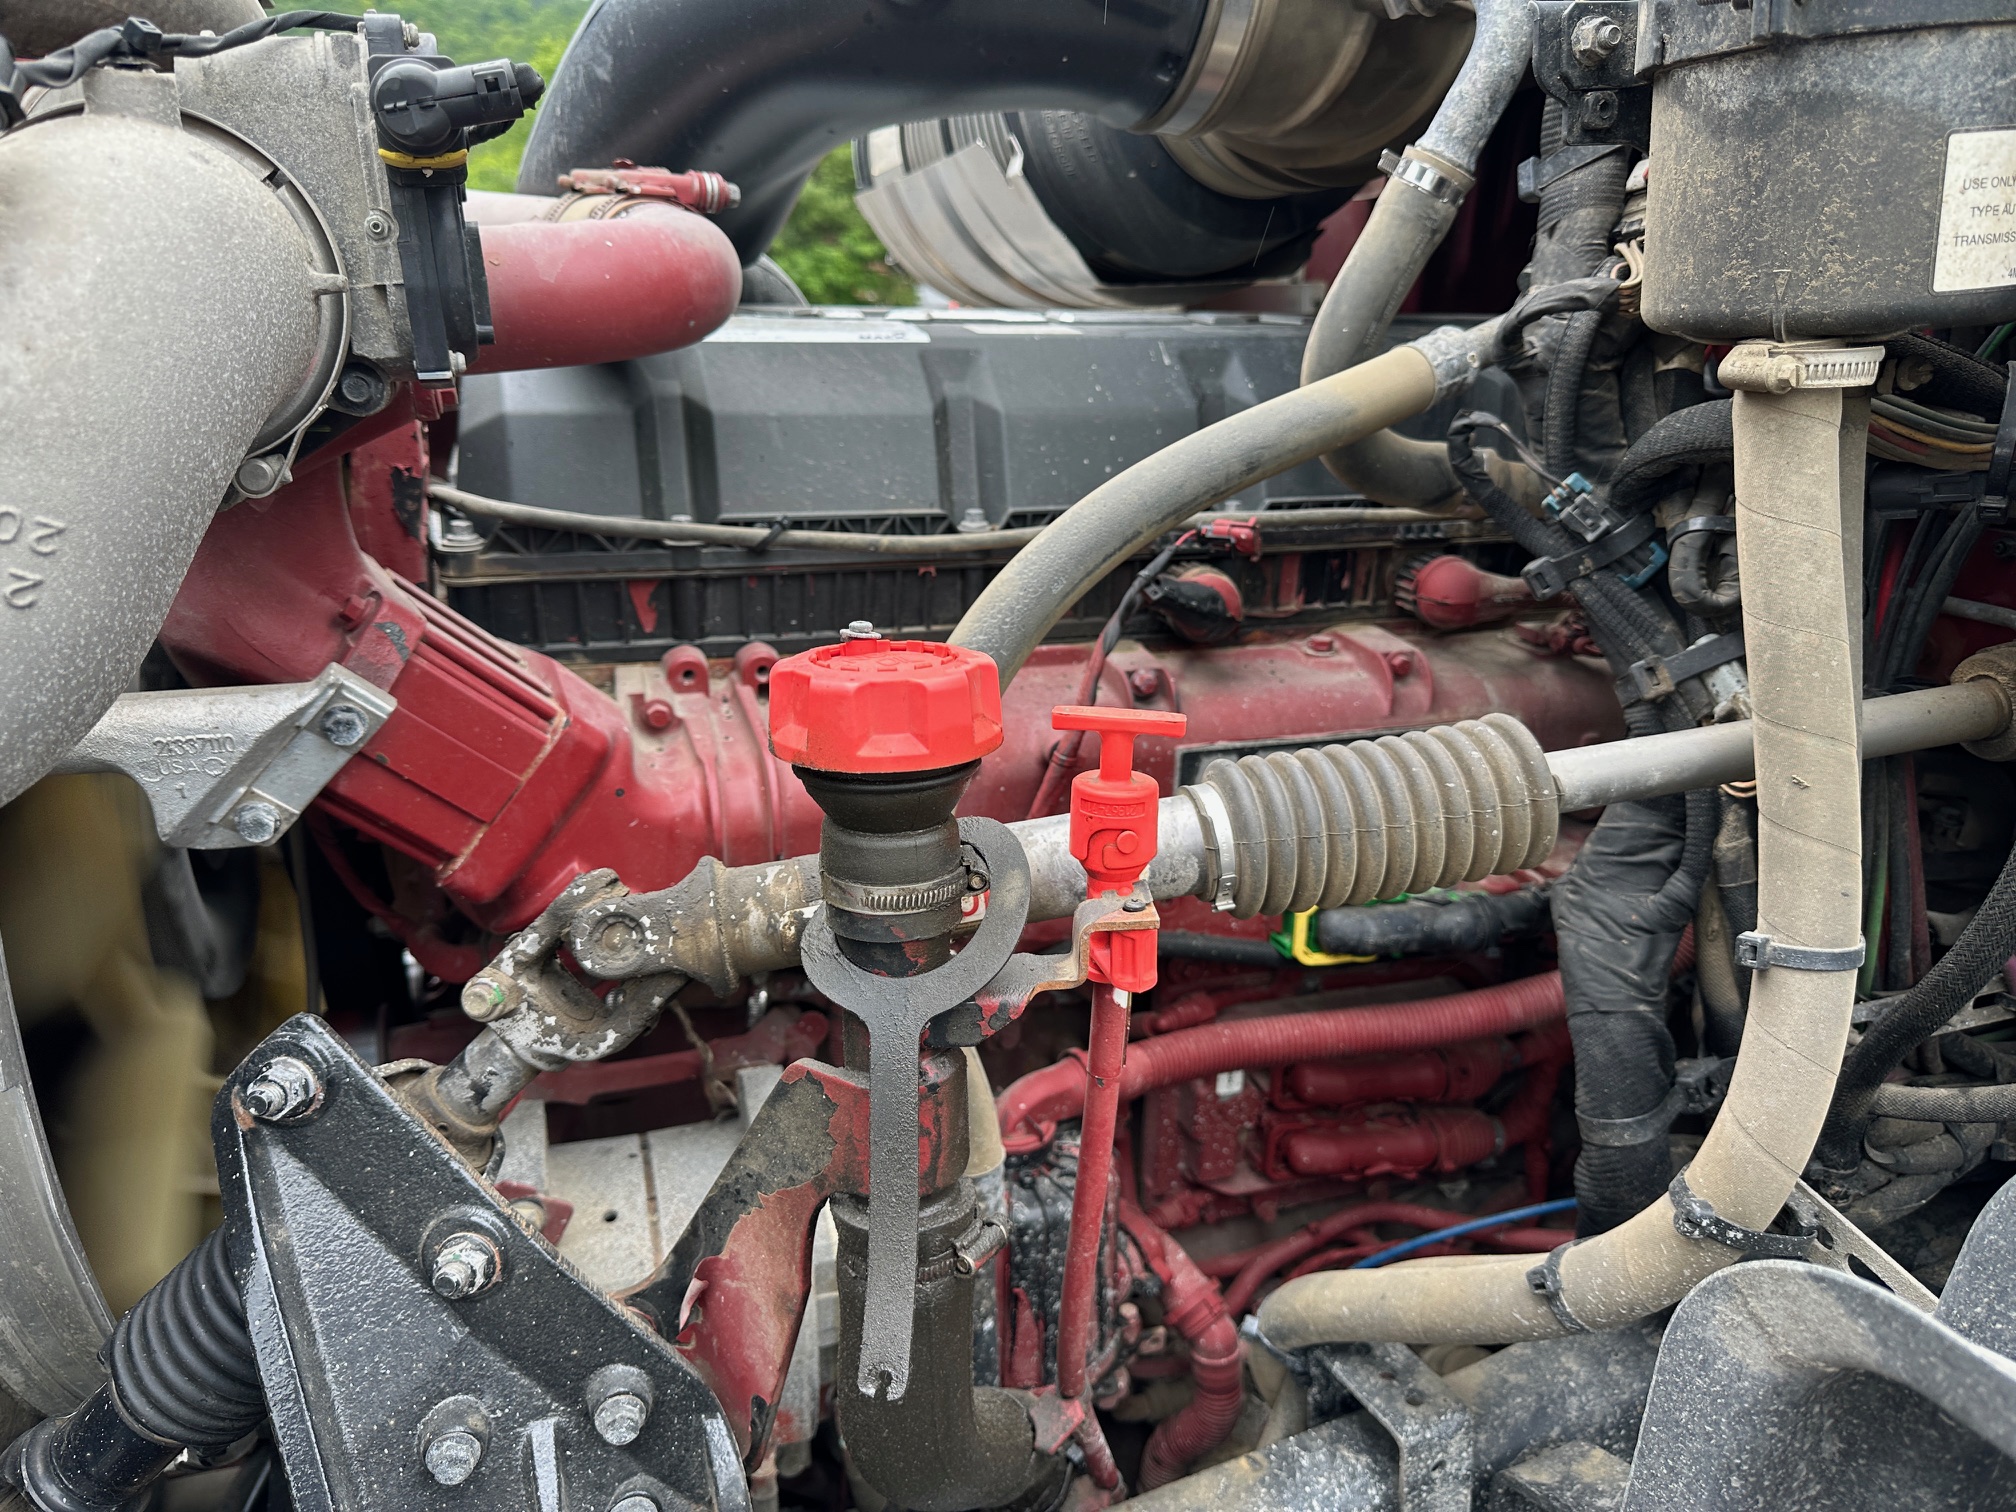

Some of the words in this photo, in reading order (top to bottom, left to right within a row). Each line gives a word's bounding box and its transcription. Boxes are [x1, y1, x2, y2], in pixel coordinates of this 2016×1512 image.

[1963, 178, 1988, 190] USE
[1970, 205, 2000, 217] TYPE
[159, 757, 203, 775] USA
